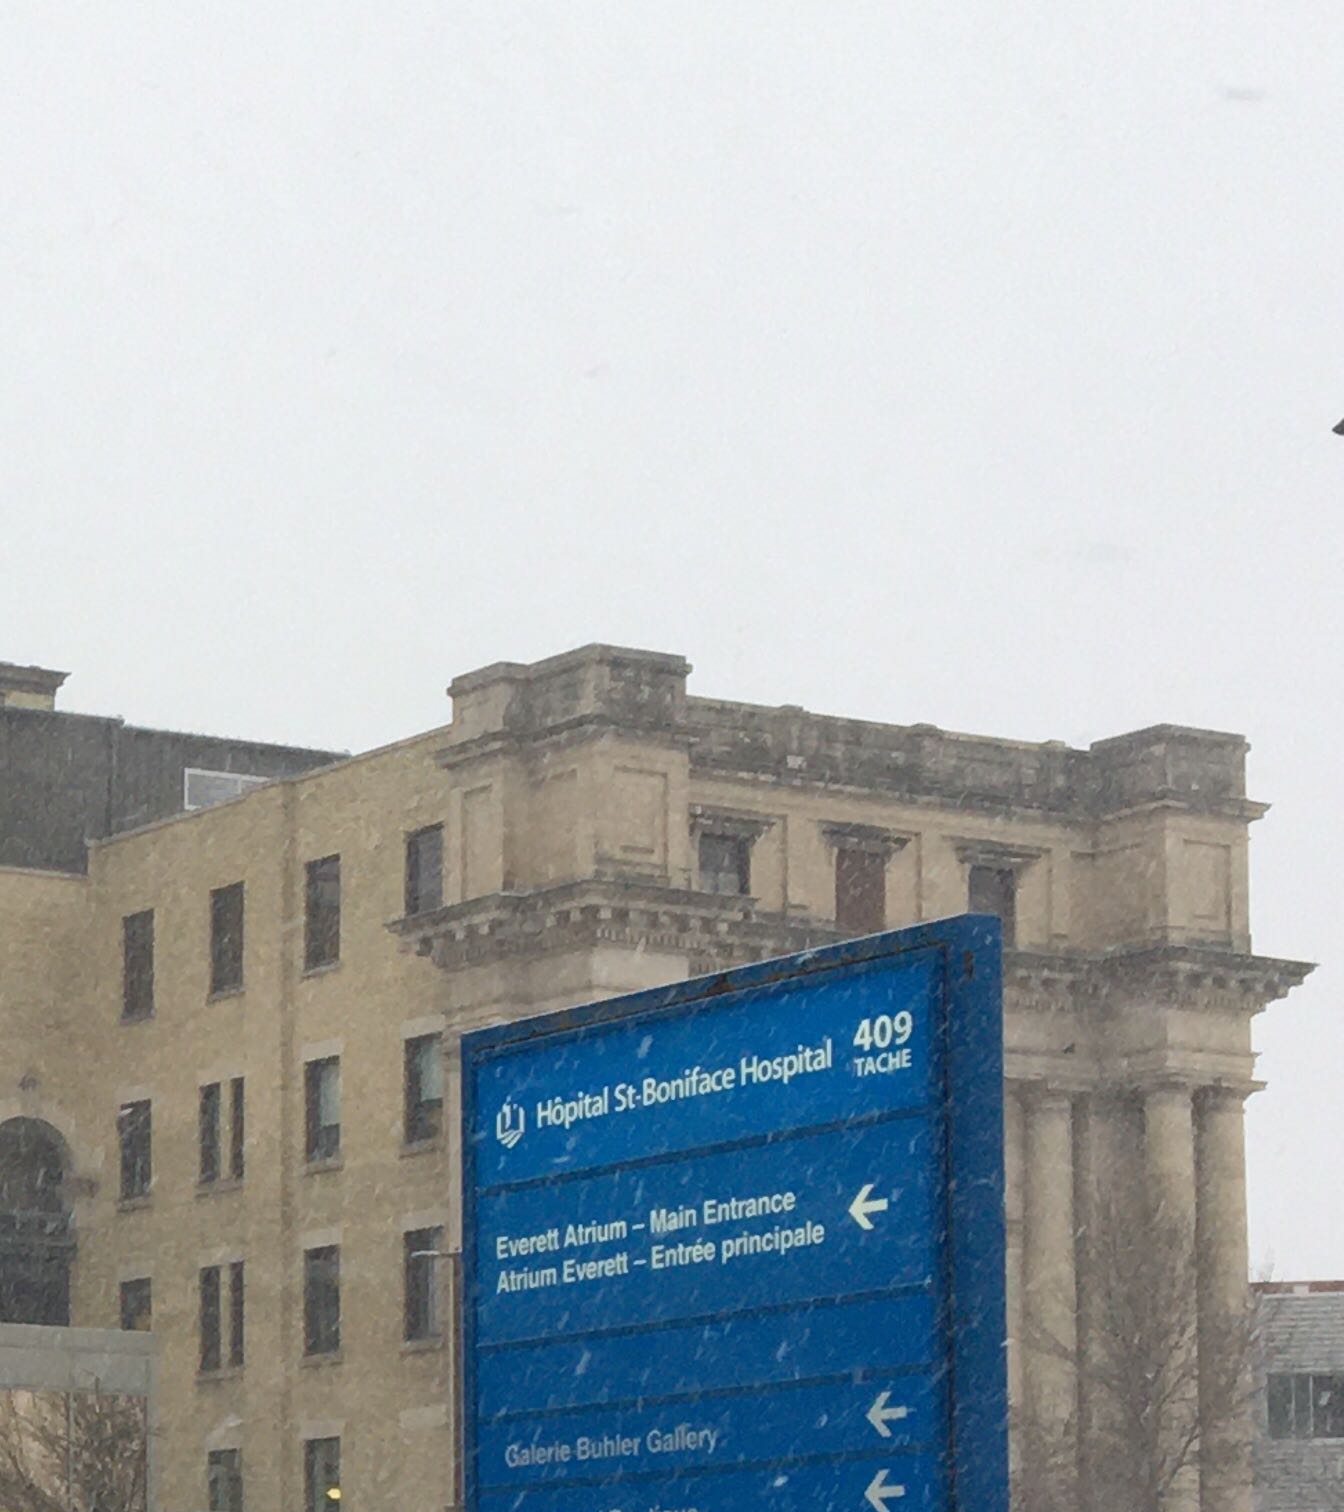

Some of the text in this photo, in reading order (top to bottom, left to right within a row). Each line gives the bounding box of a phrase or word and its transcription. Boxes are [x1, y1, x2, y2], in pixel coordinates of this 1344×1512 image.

[853, 1010, 913, 1052] 409
[536, 1037, 832, 1130] Hôpital St-Boniface Hospital
[854, 1048, 913, 1078] TACHE
[496, 1227, 560, 1261] Everett
[563, 1219, 628, 1249] Atrium
[649, 1204, 698, 1234] Main
[703, 1191, 797, 1226] Entrance
[496, 1266, 558, 1296] Atrium
[562, 1250, 630, 1284] Everett
[650, 1237, 717, 1270] Entrée
[721, 1219, 826, 1266] principale
[504, 1423, 718, 1468] Galerie Buhler Gallery
